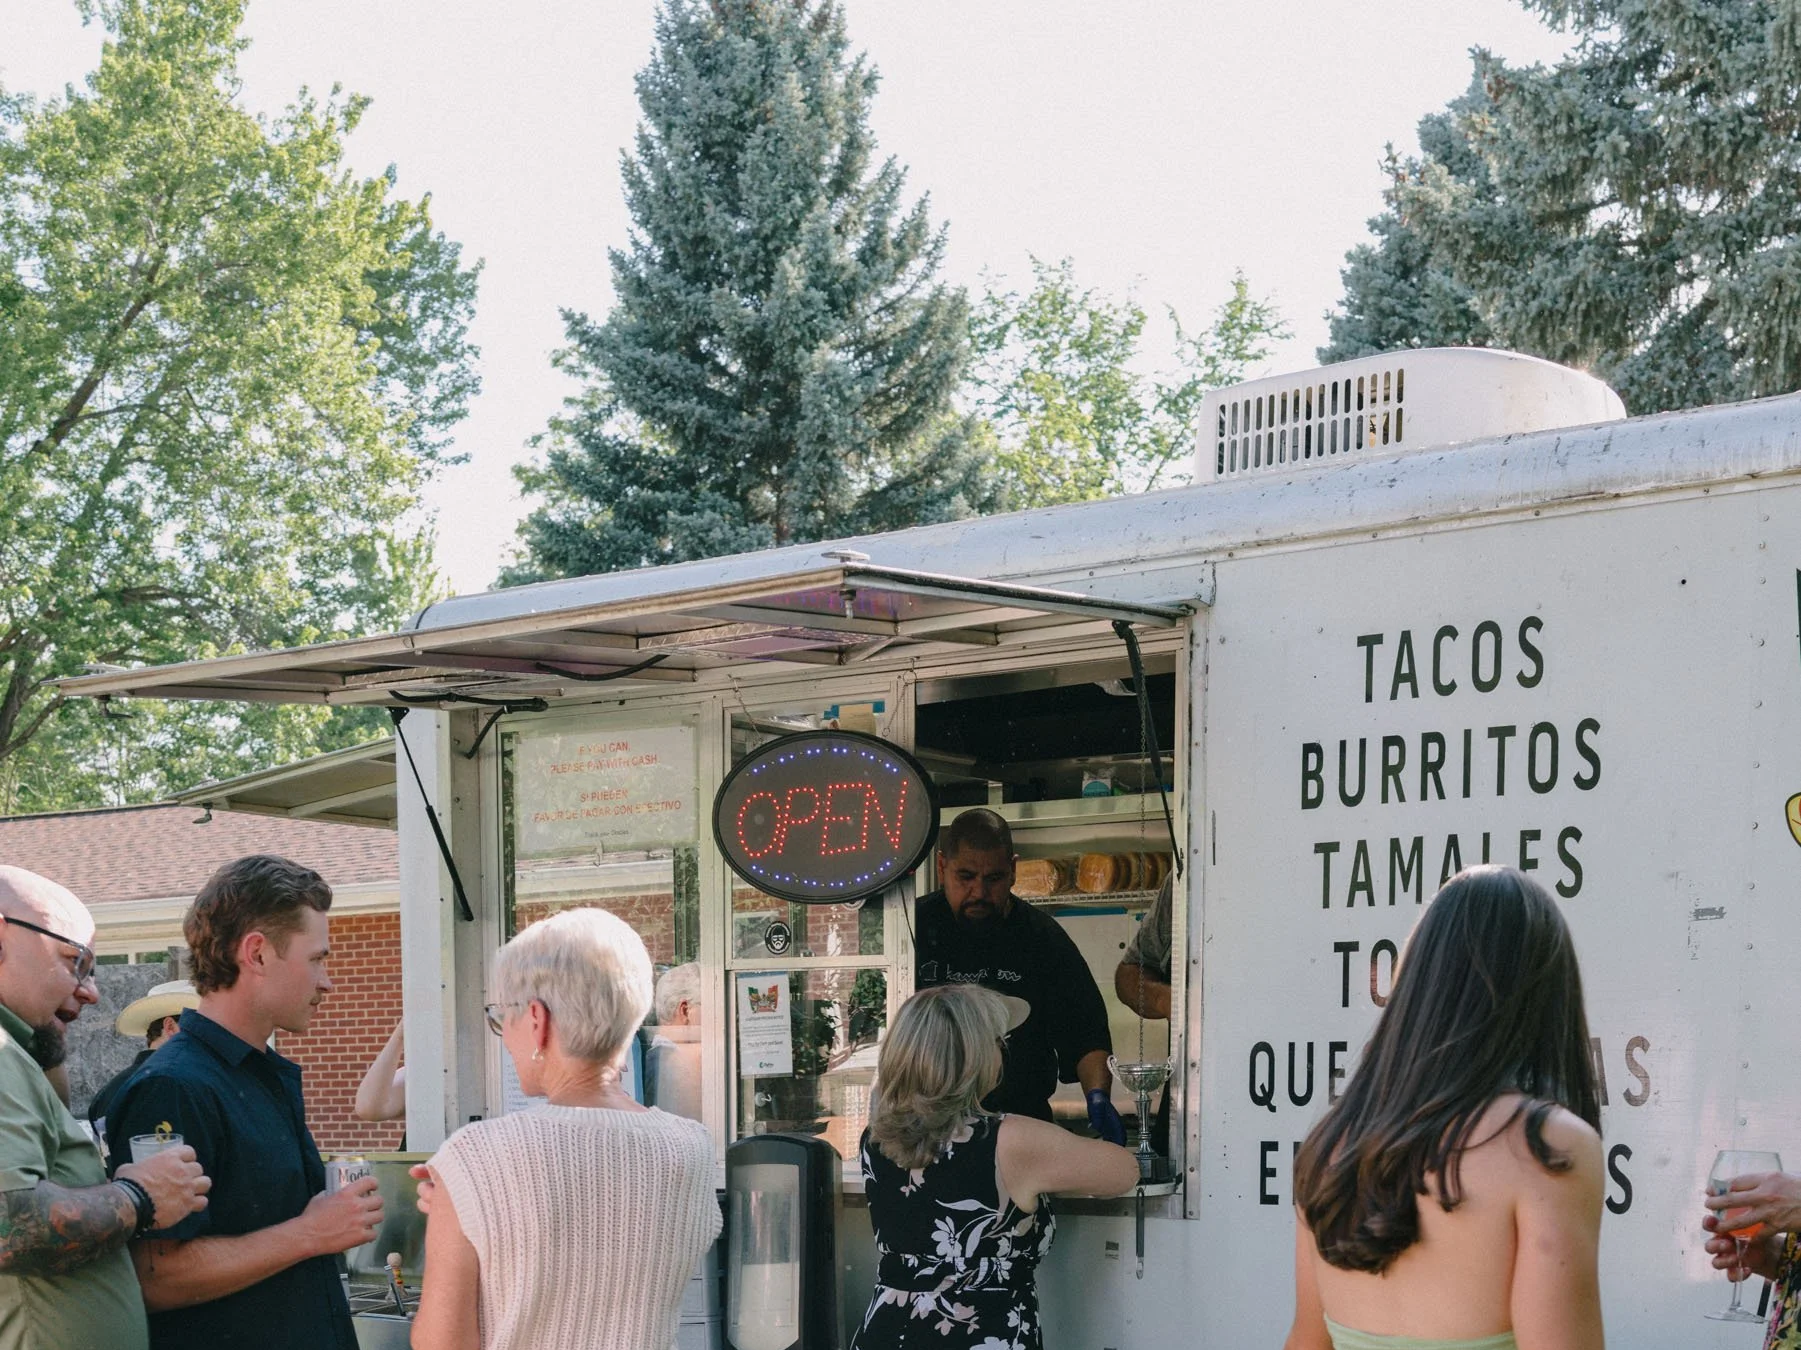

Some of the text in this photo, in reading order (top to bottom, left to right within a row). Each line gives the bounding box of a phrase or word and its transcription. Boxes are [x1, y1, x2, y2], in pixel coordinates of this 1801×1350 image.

[1357, 616, 1544, 703] TACOS
[1301, 718, 1601, 810] BURRITOS
[737, 779, 909, 858] OPEN
[1314, 826, 1583, 908] TAMAES
